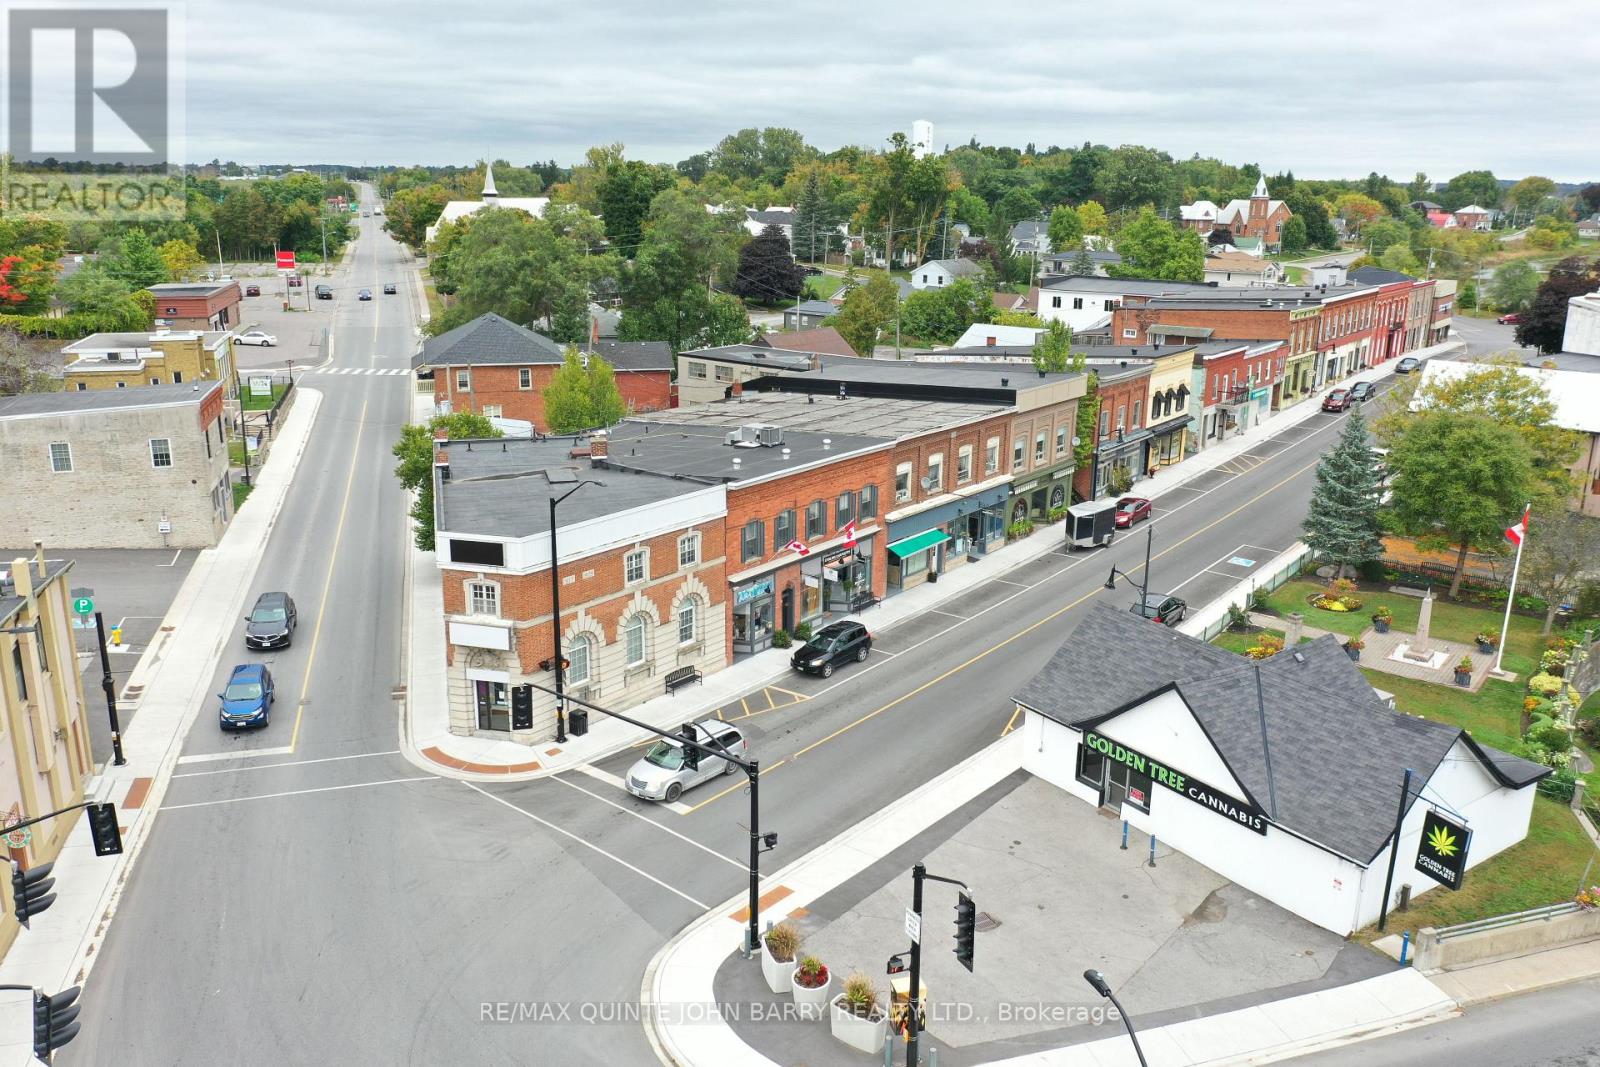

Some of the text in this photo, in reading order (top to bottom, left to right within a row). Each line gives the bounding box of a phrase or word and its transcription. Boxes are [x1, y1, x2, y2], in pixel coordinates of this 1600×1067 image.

[79, 599, 88, 609] P
[1087, 733, 1146, 773] GOLDEN
[1148, 762, 1185, 792] TREE
[1188, 787, 1262, 830] CANNABIS
[1418, 859, 1455, 882] CANNABIS
[1419, 854, 1456, 877] GOLDEN TREE
